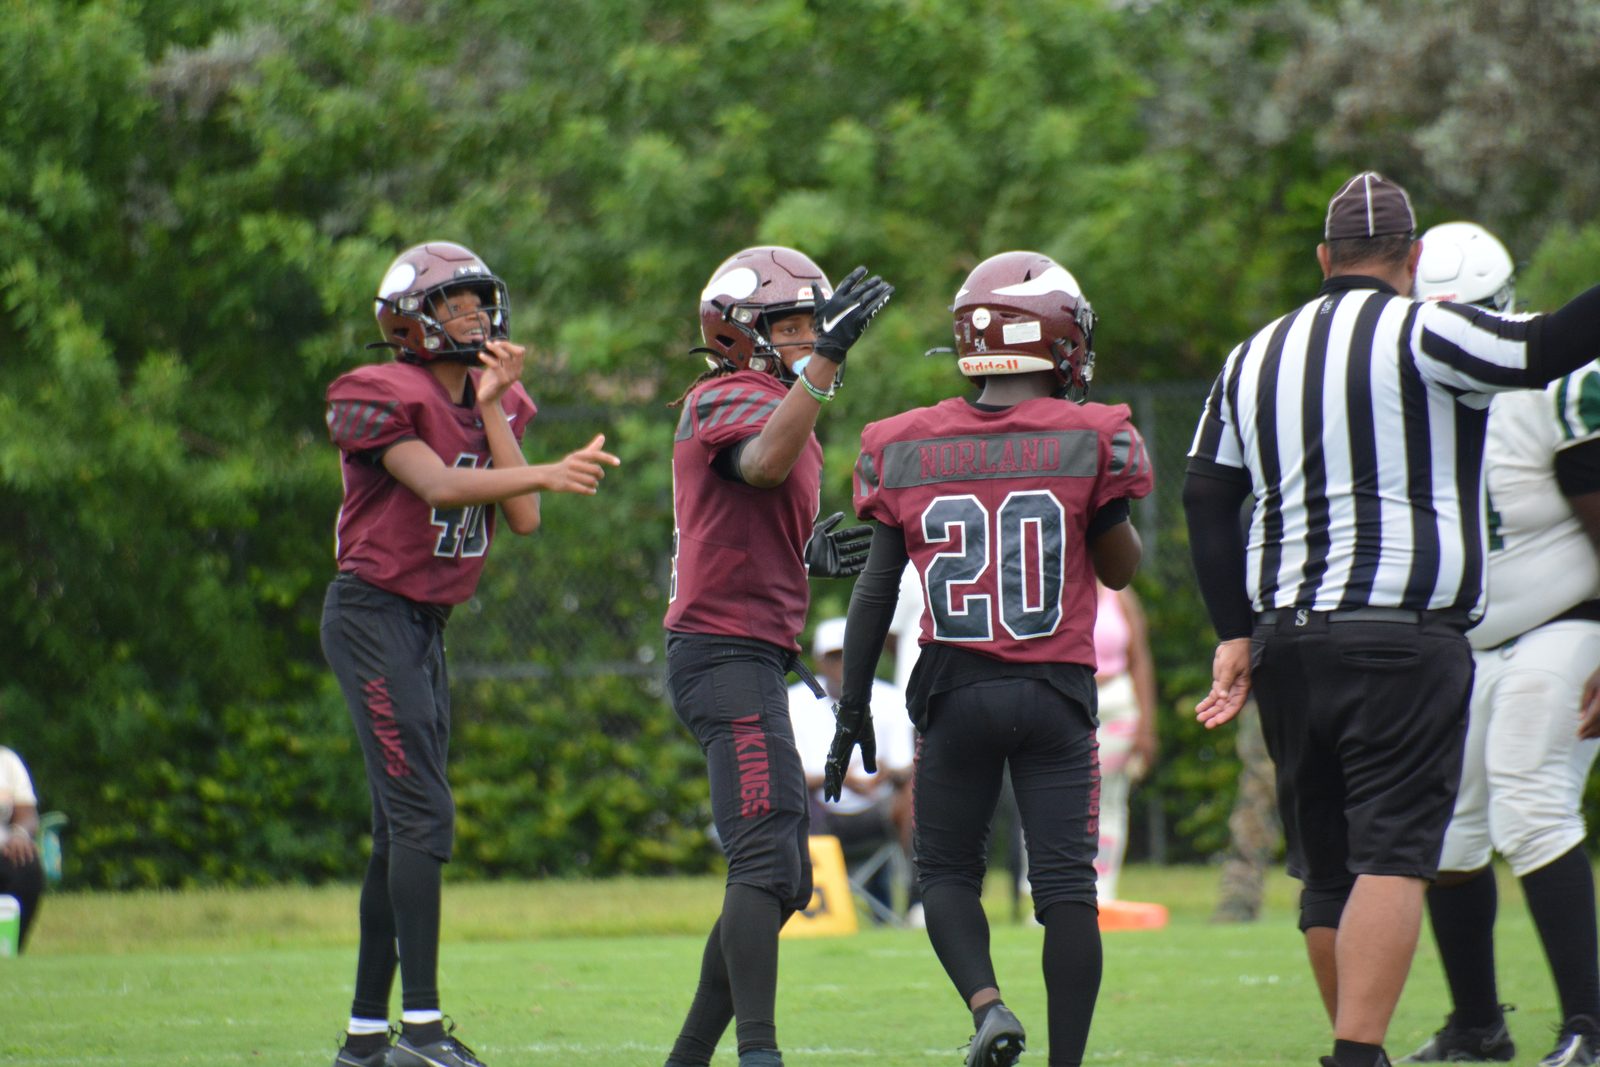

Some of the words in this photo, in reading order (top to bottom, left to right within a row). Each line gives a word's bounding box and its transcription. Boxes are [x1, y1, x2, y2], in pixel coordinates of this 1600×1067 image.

[919, 437, 1060, 480] NORLAND
[921, 489, 1066, 641] 20
[732, 712, 770, 818] VIKINGS
